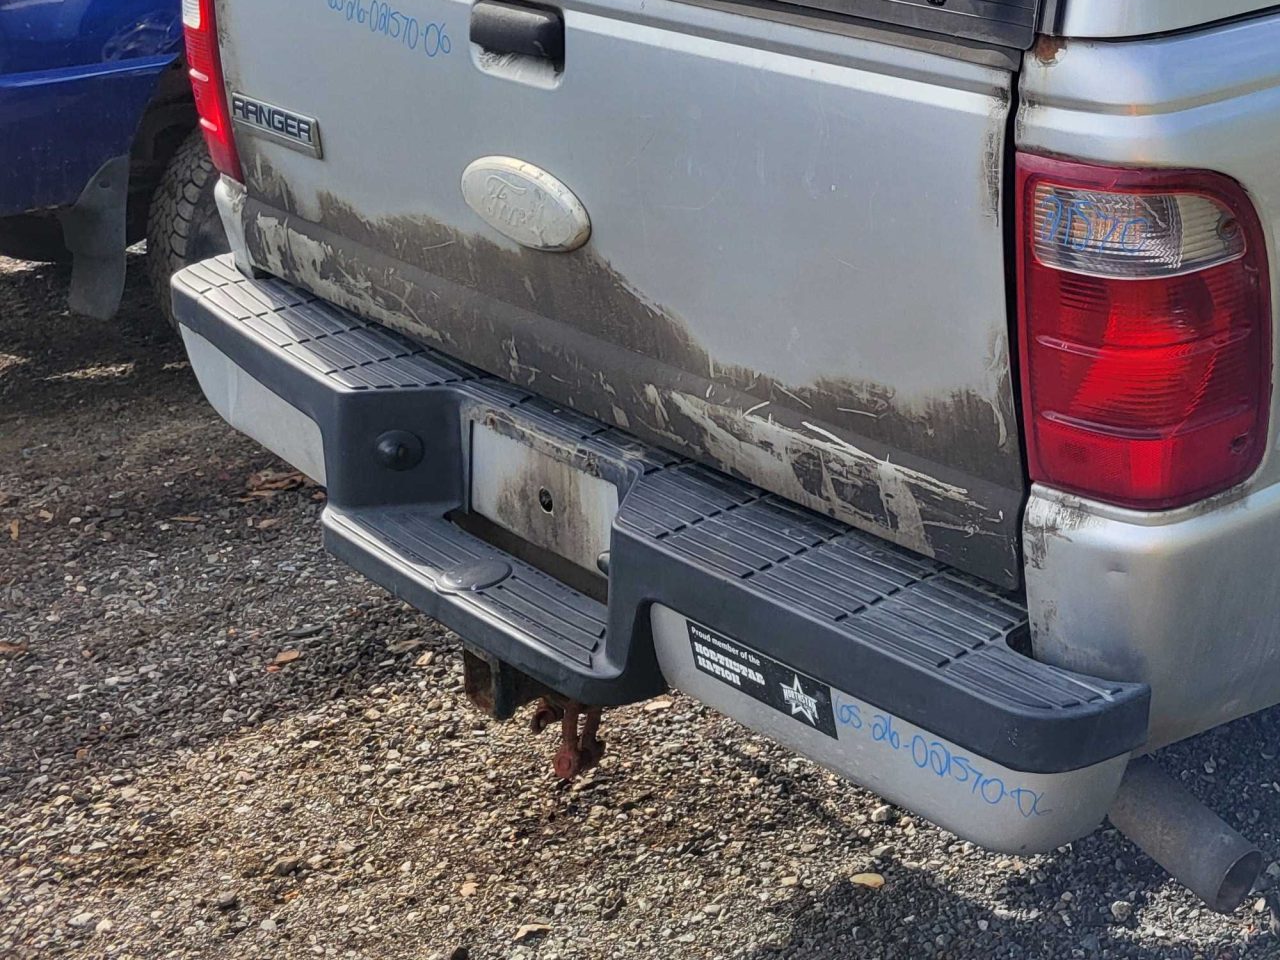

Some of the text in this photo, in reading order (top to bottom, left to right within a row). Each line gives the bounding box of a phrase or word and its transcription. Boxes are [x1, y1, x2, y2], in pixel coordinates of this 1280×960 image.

[231, 96, 313, 143] RANGER
[691, 625, 761, 666] Proud member of the
[694, 641, 766, 686] NORTHSTAR
[697, 655, 742, 686] NATION
